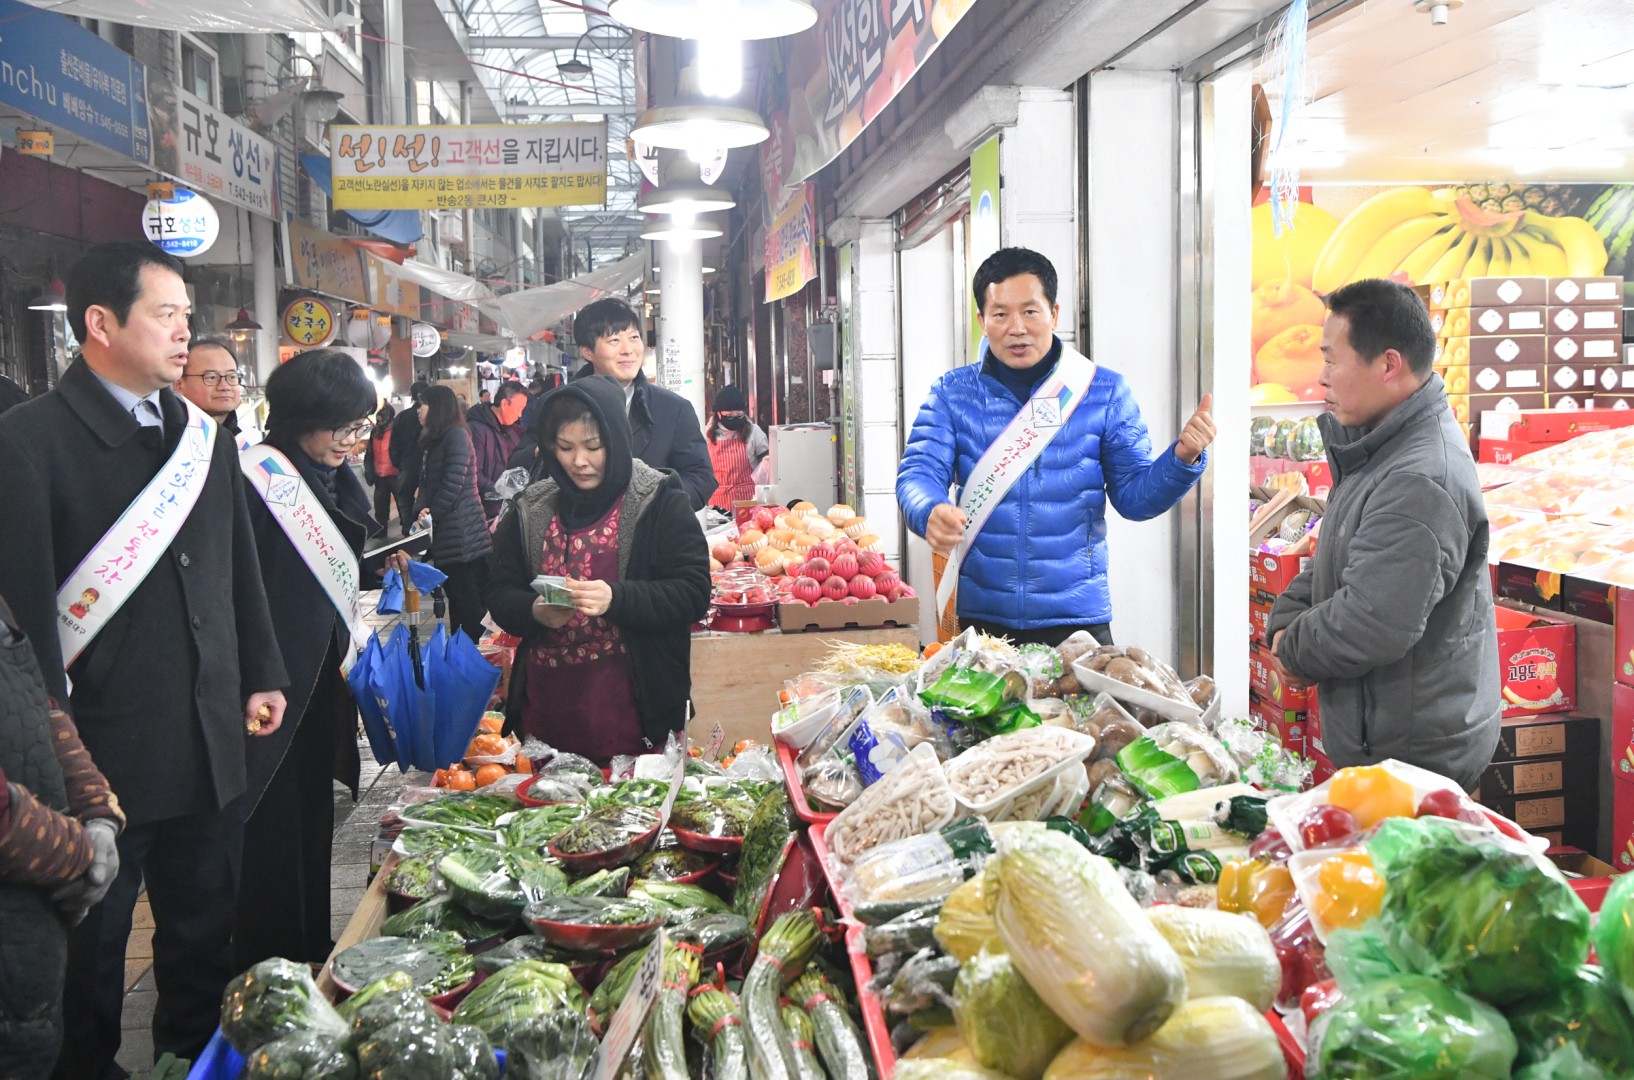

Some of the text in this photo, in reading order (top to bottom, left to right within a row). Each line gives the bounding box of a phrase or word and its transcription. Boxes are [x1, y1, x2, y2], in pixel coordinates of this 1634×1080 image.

[183, 101, 222, 164] 규호
[228, 128, 261, 185] 생선
[446, 138, 520, 166] 고객선을
[526, 135, 603, 164] 지킵시다.
[338, 179, 409, 192] 고객선(노란실선)을
[411, 178, 436, 191] 지키지
[438, 178, 454, 191] 않는
[456, 177, 496, 190] 업소에서는
[499, 177, 522, 190] 물건을
[525, 176, 548, 189] 사지도
[551, 175, 575, 188] 팔지도
[437, 195, 474, 207] 반송2동
[477, 194, 507, 206] 큰시장
[93, 519, 158, 586] 전통시장
